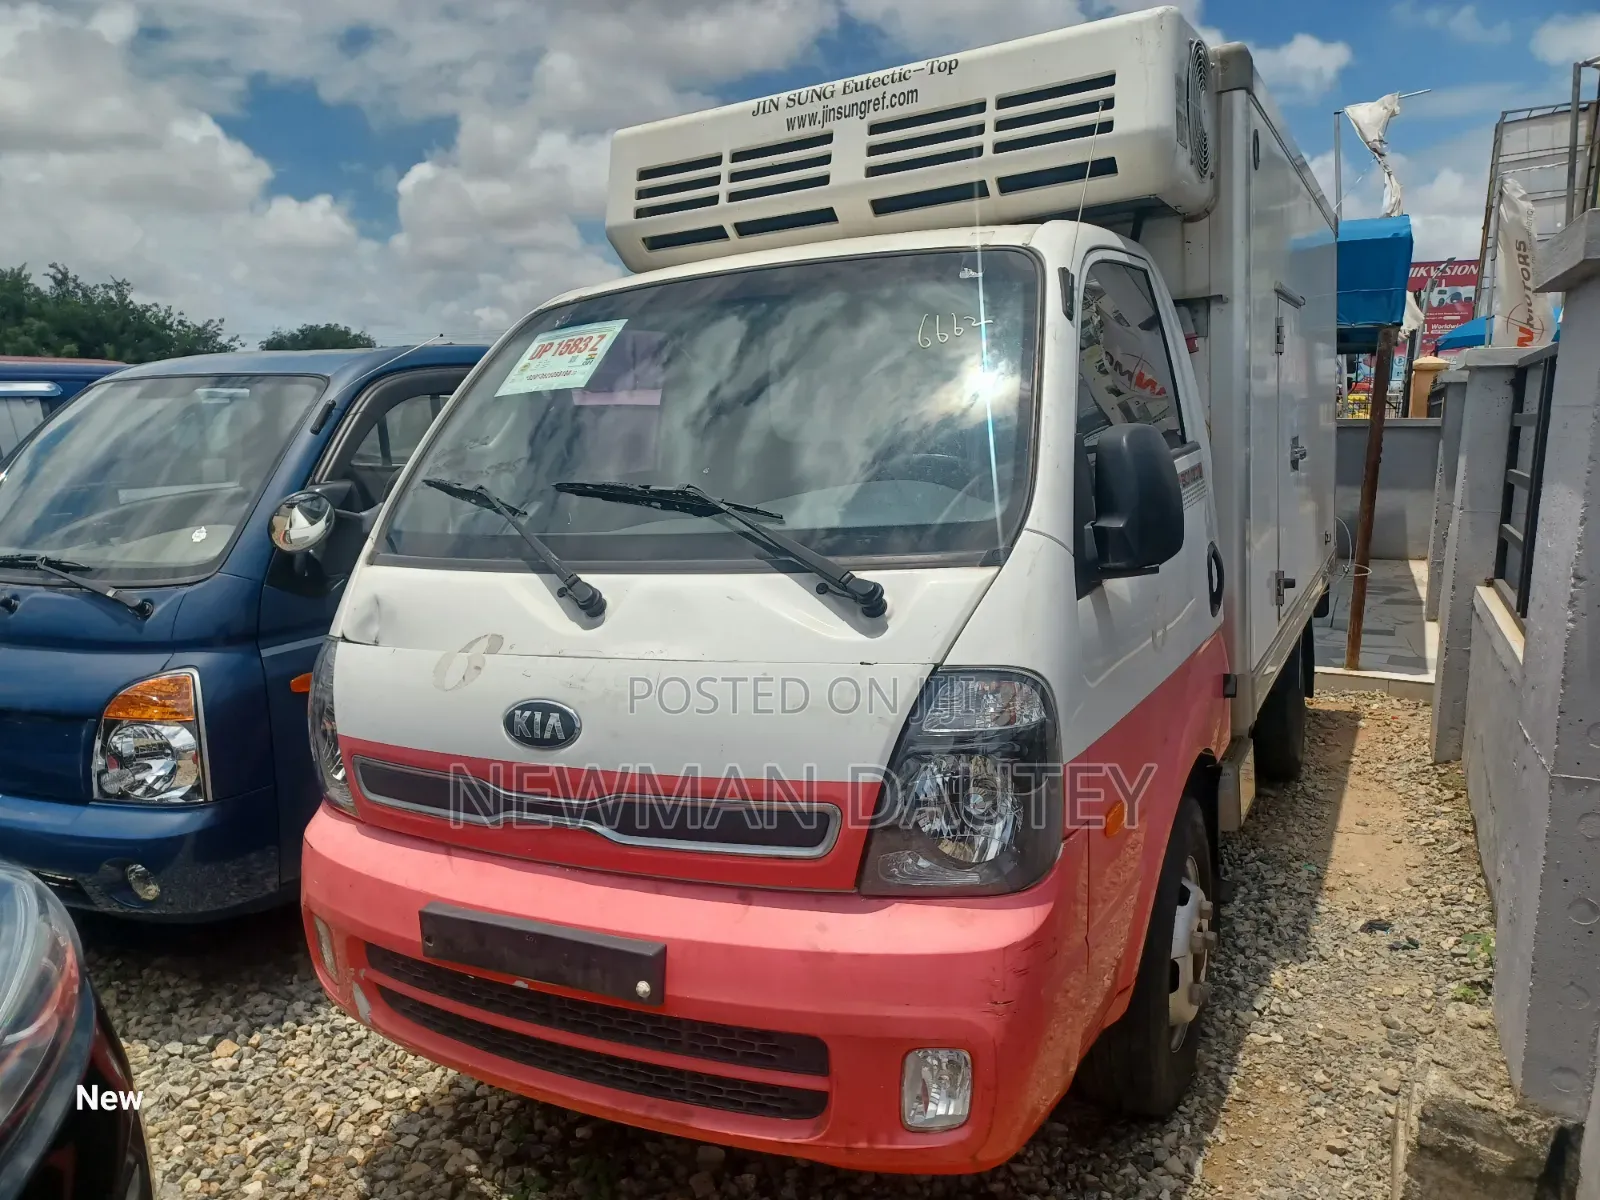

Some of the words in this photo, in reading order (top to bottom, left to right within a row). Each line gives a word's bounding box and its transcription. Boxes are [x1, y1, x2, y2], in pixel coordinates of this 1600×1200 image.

[751, 97, 781, 117] JIN
[785, 84, 836, 109] SUNG
[786, 88, 919, 132] www.jinsungref.com
[528, 342, 555, 360] DP
[552, 335, 594, 357] 1583
[513, 709, 566, 740] KIA
